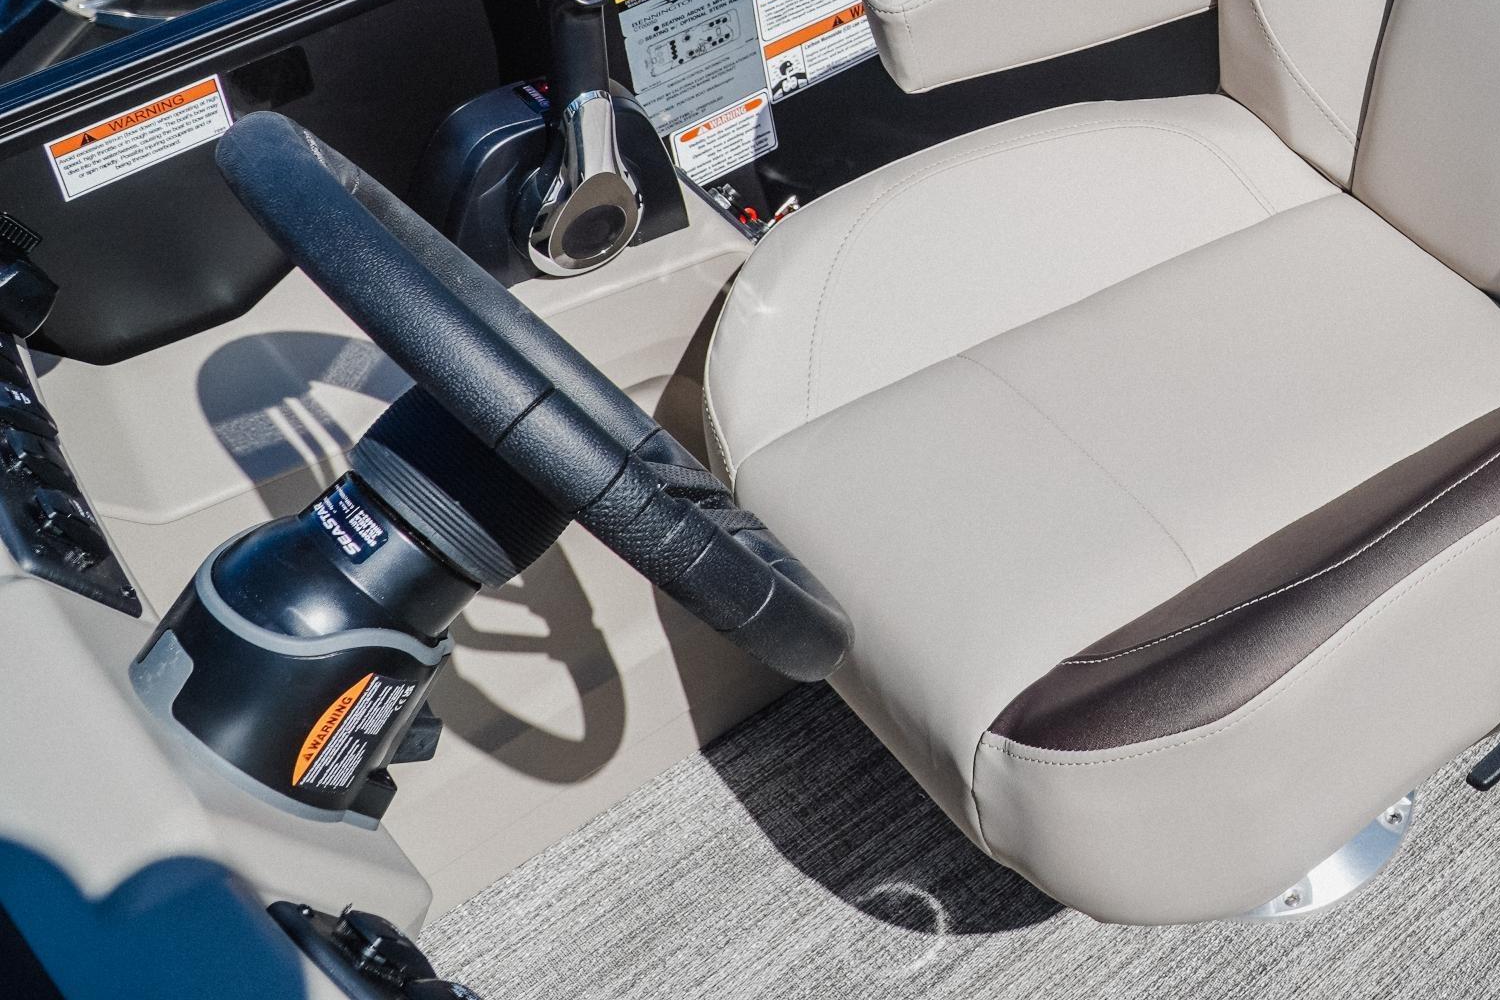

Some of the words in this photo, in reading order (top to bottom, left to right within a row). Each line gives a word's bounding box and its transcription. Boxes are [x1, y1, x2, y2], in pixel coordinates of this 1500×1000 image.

[644, 28, 668, 41] SEATING
[679, 9, 706, 25] OPTIONAL
[709, 2, 726, 12] STERN
[661, 14, 685, 27] SEATING
[686, 6, 704, 16] ABOVE
[58, 154, 75, 165] Avoid
[156, 114, 172, 124] when
[172, 103, 199, 117] operating
[205, 95, 218, 104] high
[83, 153, 96, 162] high
[96, 144, 117, 156] throttle
[131, 132, 146, 142] rough
[193, 108, 205, 116] bow
[205, 102, 217, 111] may
[107, 93, 185, 132] WARNING
[710, 104, 746, 129] WARNING
[67, 167, 79, 176] dive
[140, 133, 161, 145] causing
[172, 123, 184, 132] boat
[192, 115, 203, 123] bow
[204, 109, 218, 118] steer
[85, 166, 98, 175] spin
[120, 147, 143, 160] Possibly
[144, 138, 165, 150] injuring
[194, 121, 205, 129] and
[115, 159, 132, 170] being
[132, 151, 151, 163] thrown
[314, 502, 361, 555] SEASTAR
[310, 696, 352, 749] WARNING
